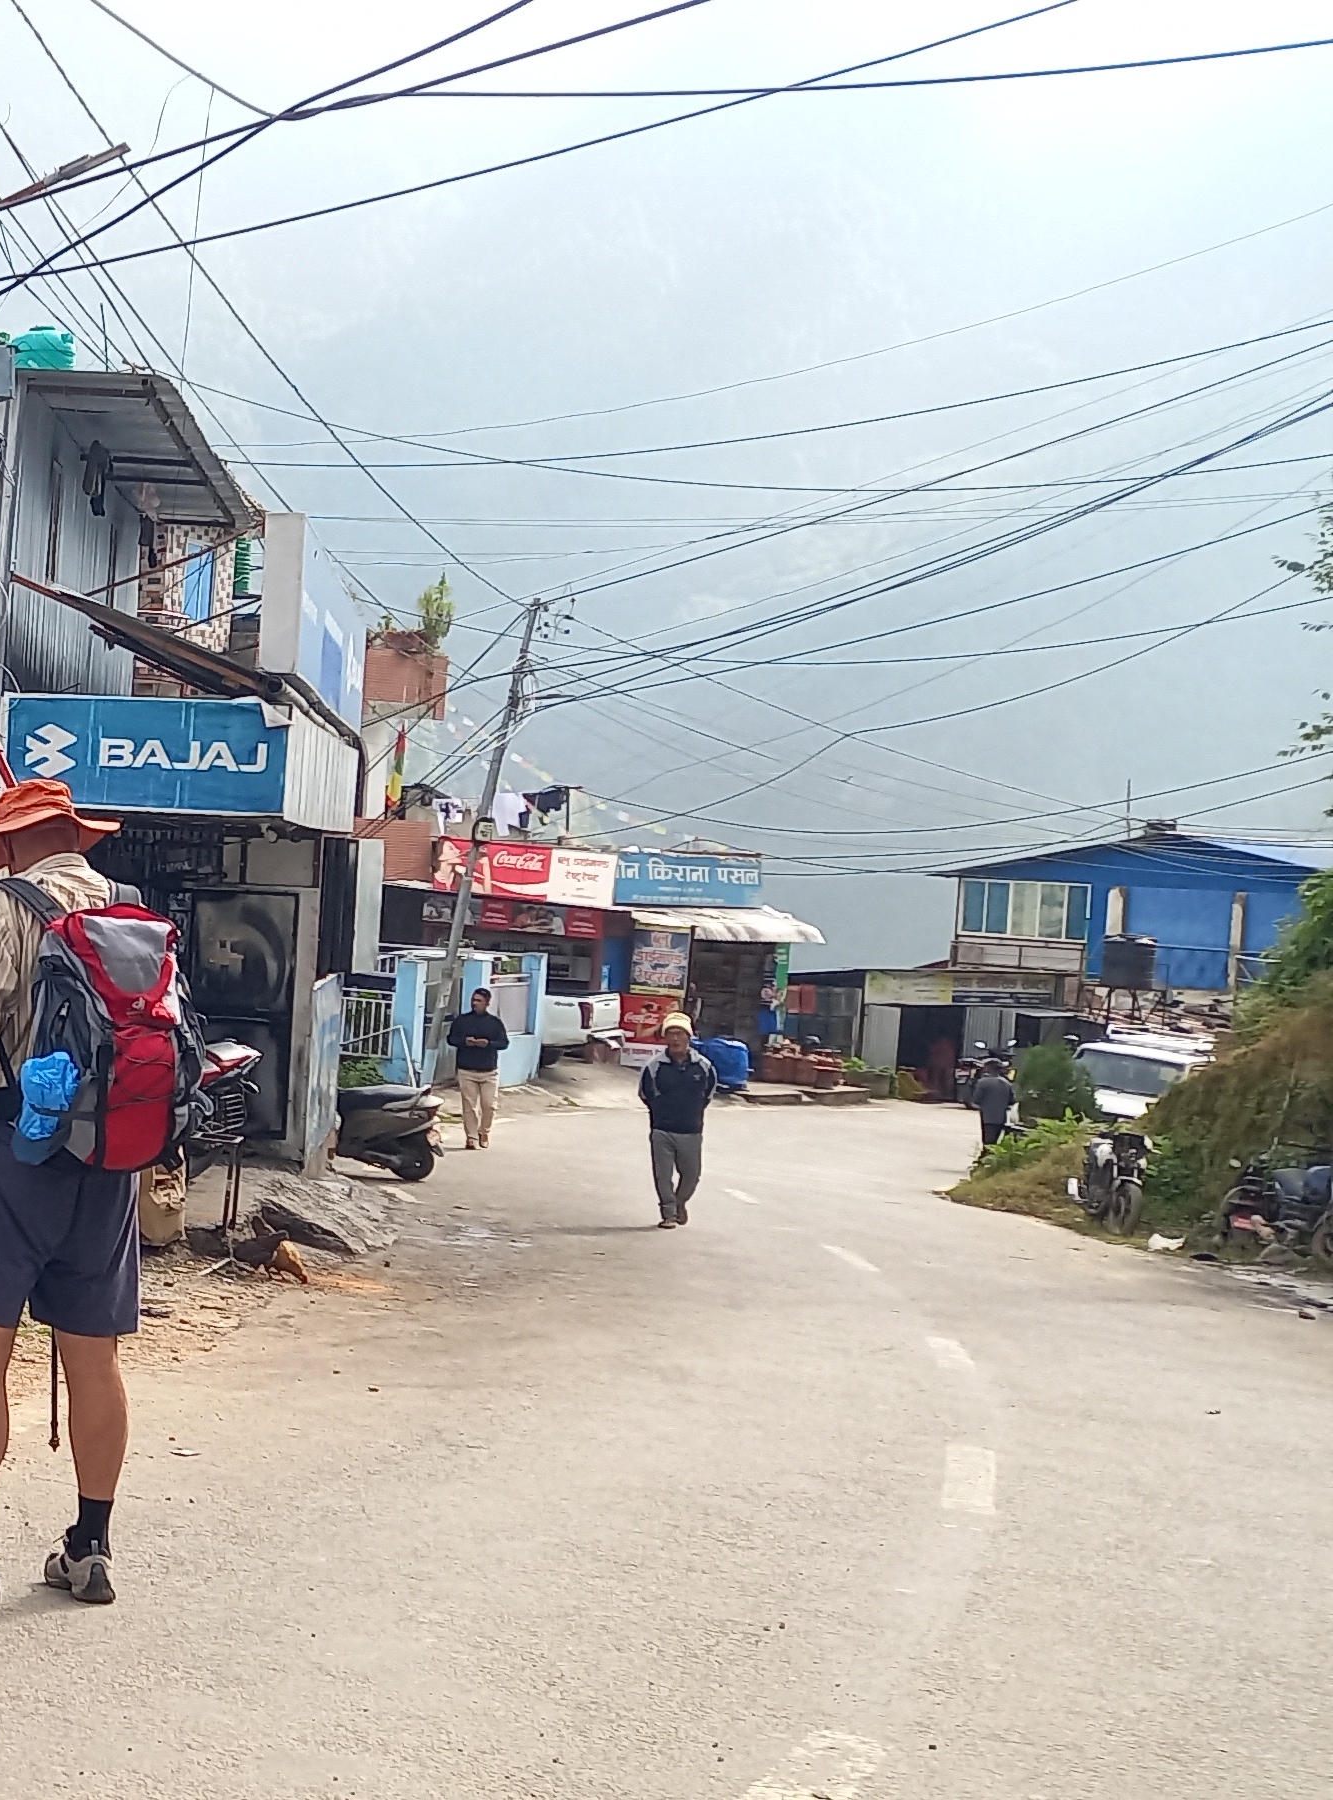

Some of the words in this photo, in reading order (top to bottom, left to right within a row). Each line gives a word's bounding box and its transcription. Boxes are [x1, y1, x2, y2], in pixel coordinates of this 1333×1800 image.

[99, 737, 269, 773] BAJAJ
[645, 857, 710, 883] किराना
[715, 866, 760, 885] पसल
